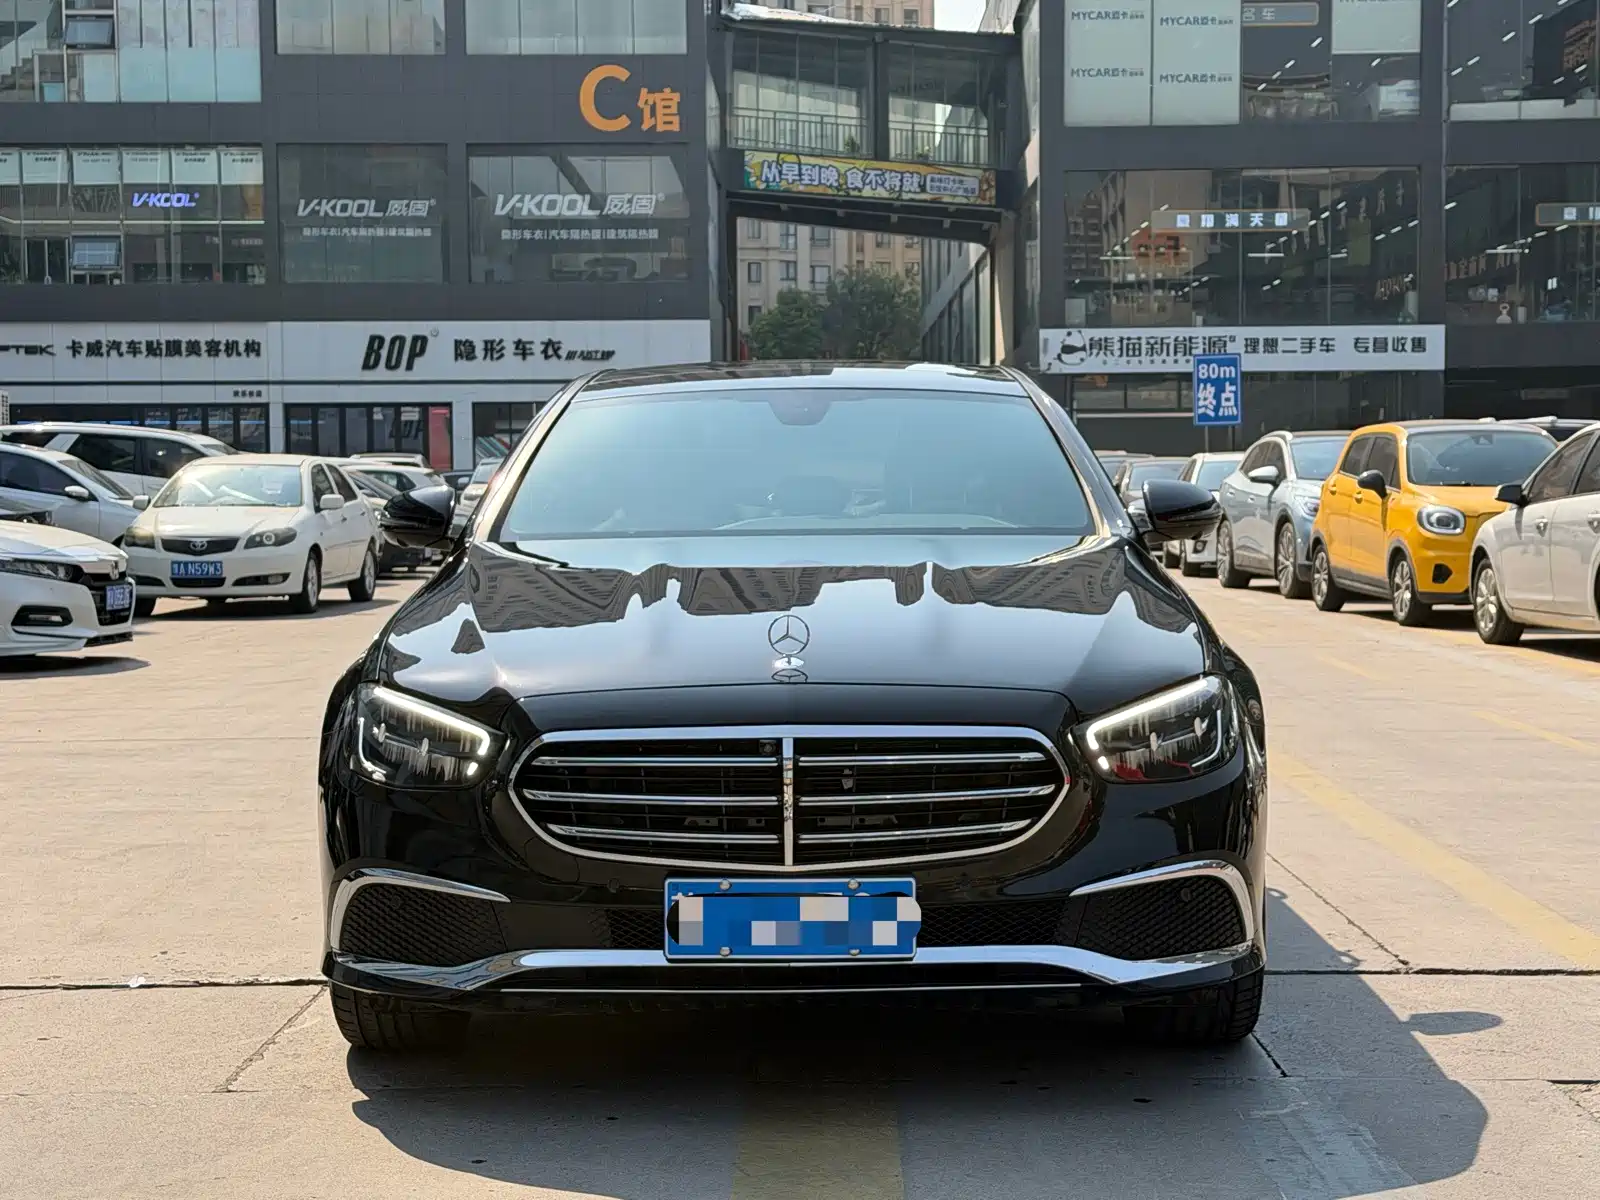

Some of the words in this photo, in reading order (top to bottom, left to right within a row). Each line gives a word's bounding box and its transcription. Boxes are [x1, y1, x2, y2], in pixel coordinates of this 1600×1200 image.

[1071, 10, 1111, 20] MYCAR
[1160, 16, 1200, 26] MYCAR
[1071, 68, 1111, 77] MYCAR
[1159, 74, 1200, 83] MYCAR
[761, 160, 839, 187] 从早到晚
[846, 167, 921, 192] 食不将就
[66, 339, 262, 358] 卡威汽车贴膜美容机构
[361, 334, 429, 371] BOP
[454, 338, 563, 361] 隐形车衣
[1088, 335, 1228, 358] 熊猫新能源
[1244, 337, 1336, 354] 理想二手车
[1353, 336, 1427, 353] 专营收售
[1198, 363, 1236, 378] 80m
[1198, 381, 1237, 417] 终点
